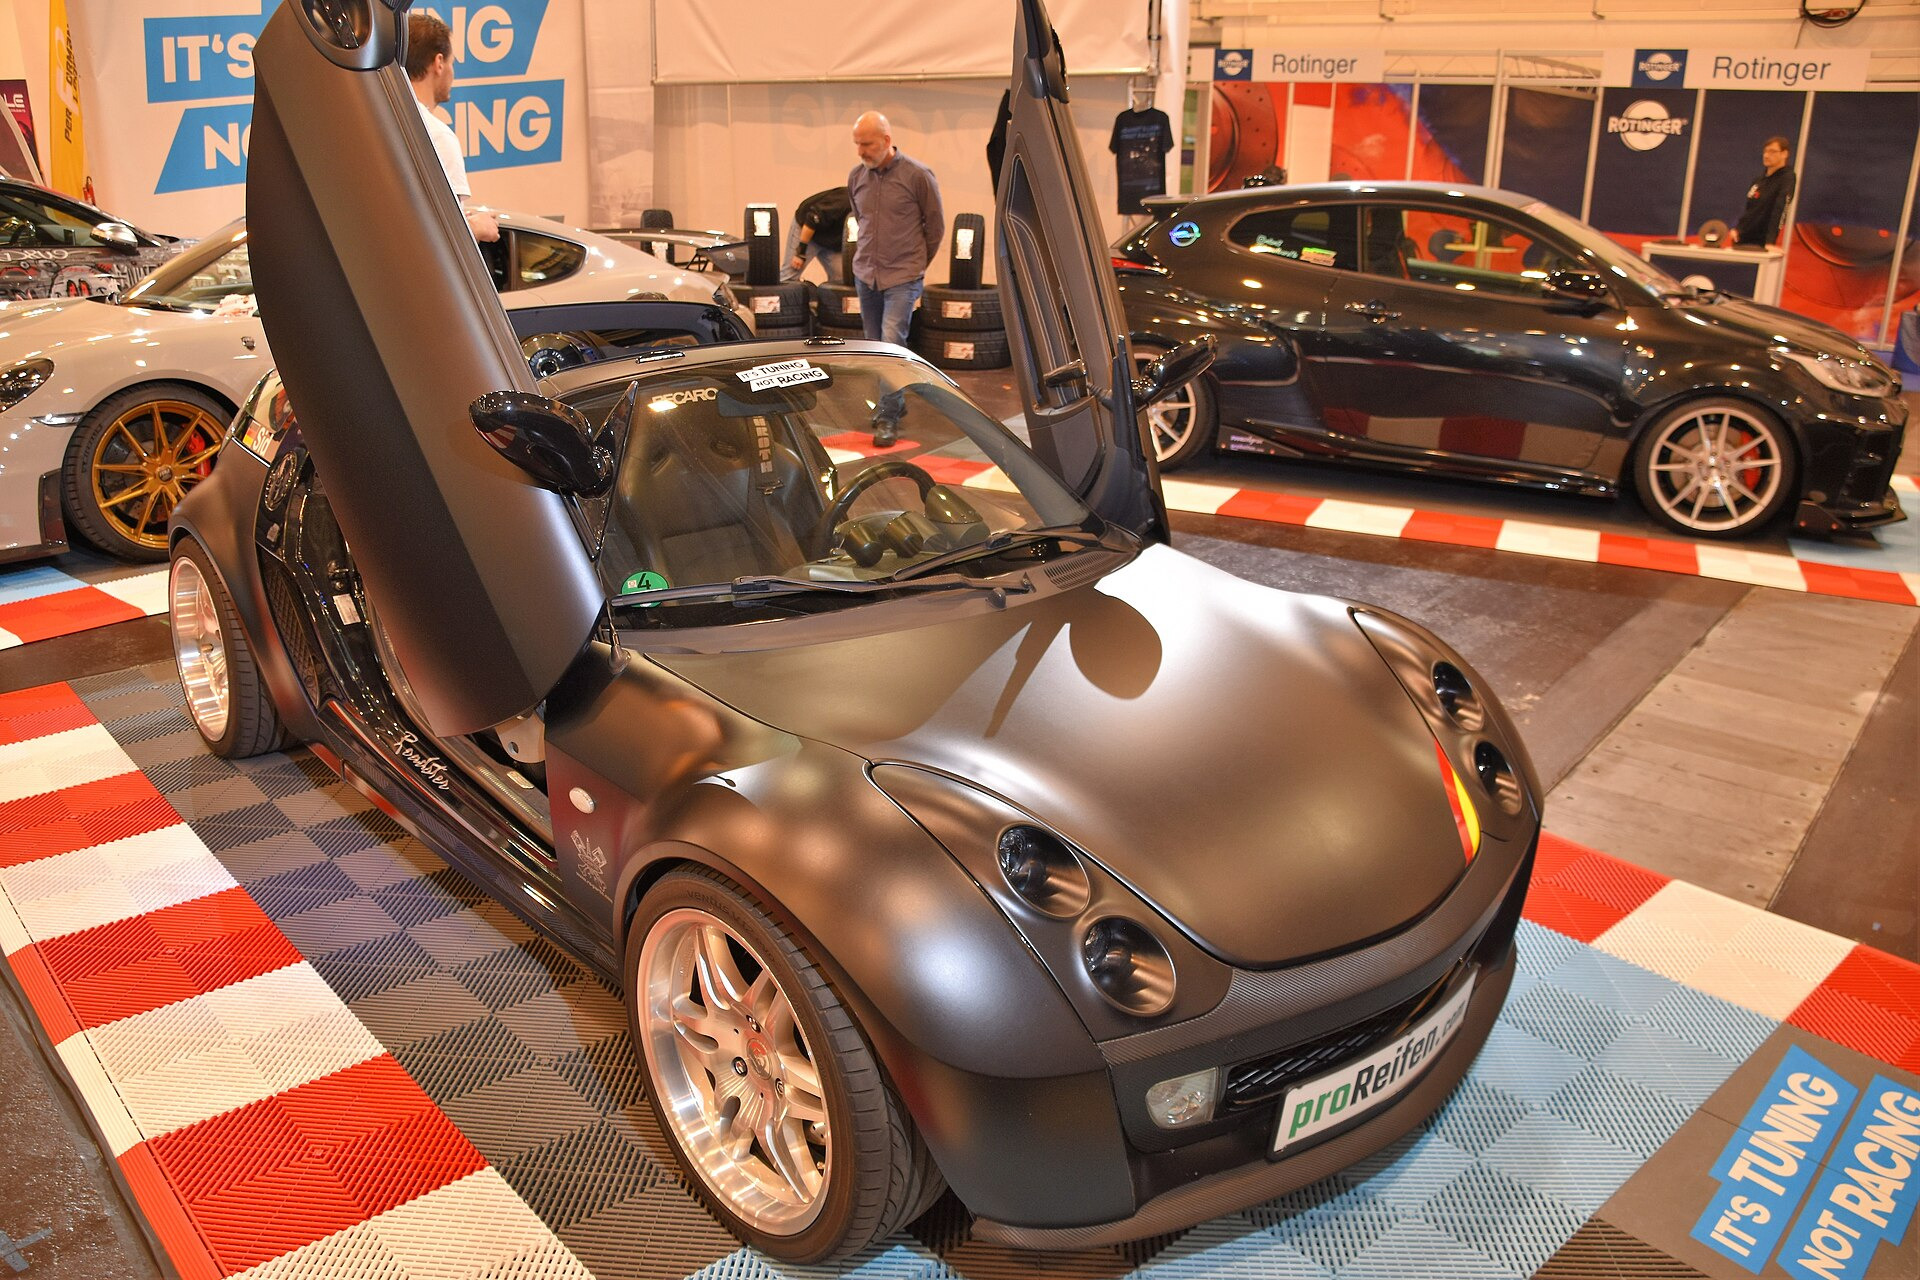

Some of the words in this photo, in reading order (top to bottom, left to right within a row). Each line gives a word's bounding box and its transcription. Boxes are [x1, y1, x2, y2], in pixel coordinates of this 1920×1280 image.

[162, 33, 256, 84] IT'S
[1272, 54, 1358, 79] Rotinger
[1713, 56, 1831, 86] Rotinger
[1607, 116, 1683, 135] ROTINGER
[741, 371, 759, 380] IT'S
[758, 361, 804, 375] TUNING
[756, 378, 775, 388] NOT
[777, 370, 823, 385] RACING
[252, 426, 275, 457] Sid
[637, 573, 651, 590] 4
[394, 731, 449, 790] Roadster
[1288, 1000, 1466, 1140] proReifen.com
[1727, 1072, 1839, 1197] TUNING
[1796, 1208, 1861, 1280] NOT
[1829, 1091, 1920, 1229] RACING
[1710, 1195, 1771, 1257] IT'S
